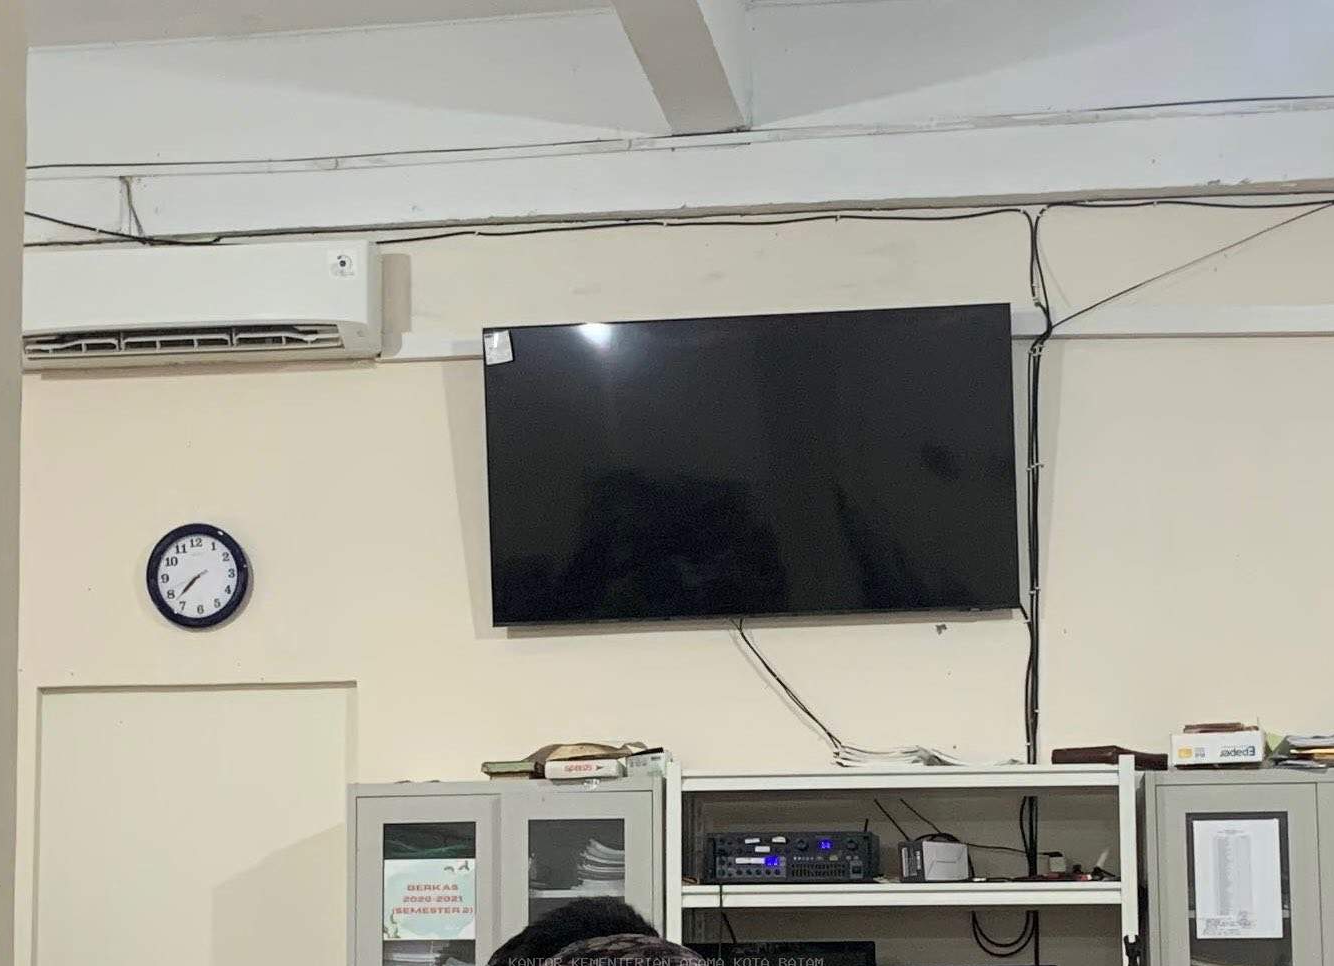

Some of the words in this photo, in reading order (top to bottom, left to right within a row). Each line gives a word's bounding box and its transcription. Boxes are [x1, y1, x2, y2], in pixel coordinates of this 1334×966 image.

[190, 538, 203, 548] 12
[211, 541, 217, 551] 1
[175, 543, 187, 554] 11
[166, 556, 178, 567] 10
[222, 552, 230, 561] 2
[161, 573, 169, 583] 9
[228, 568, 235, 578] 3
[167, 589, 175, 599] 8
[225, 585, 232, 595] 4
[179, 601, 186, 611] 7
[214, 598, 221, 608] 5
[197, 604, 204, 614] 6
